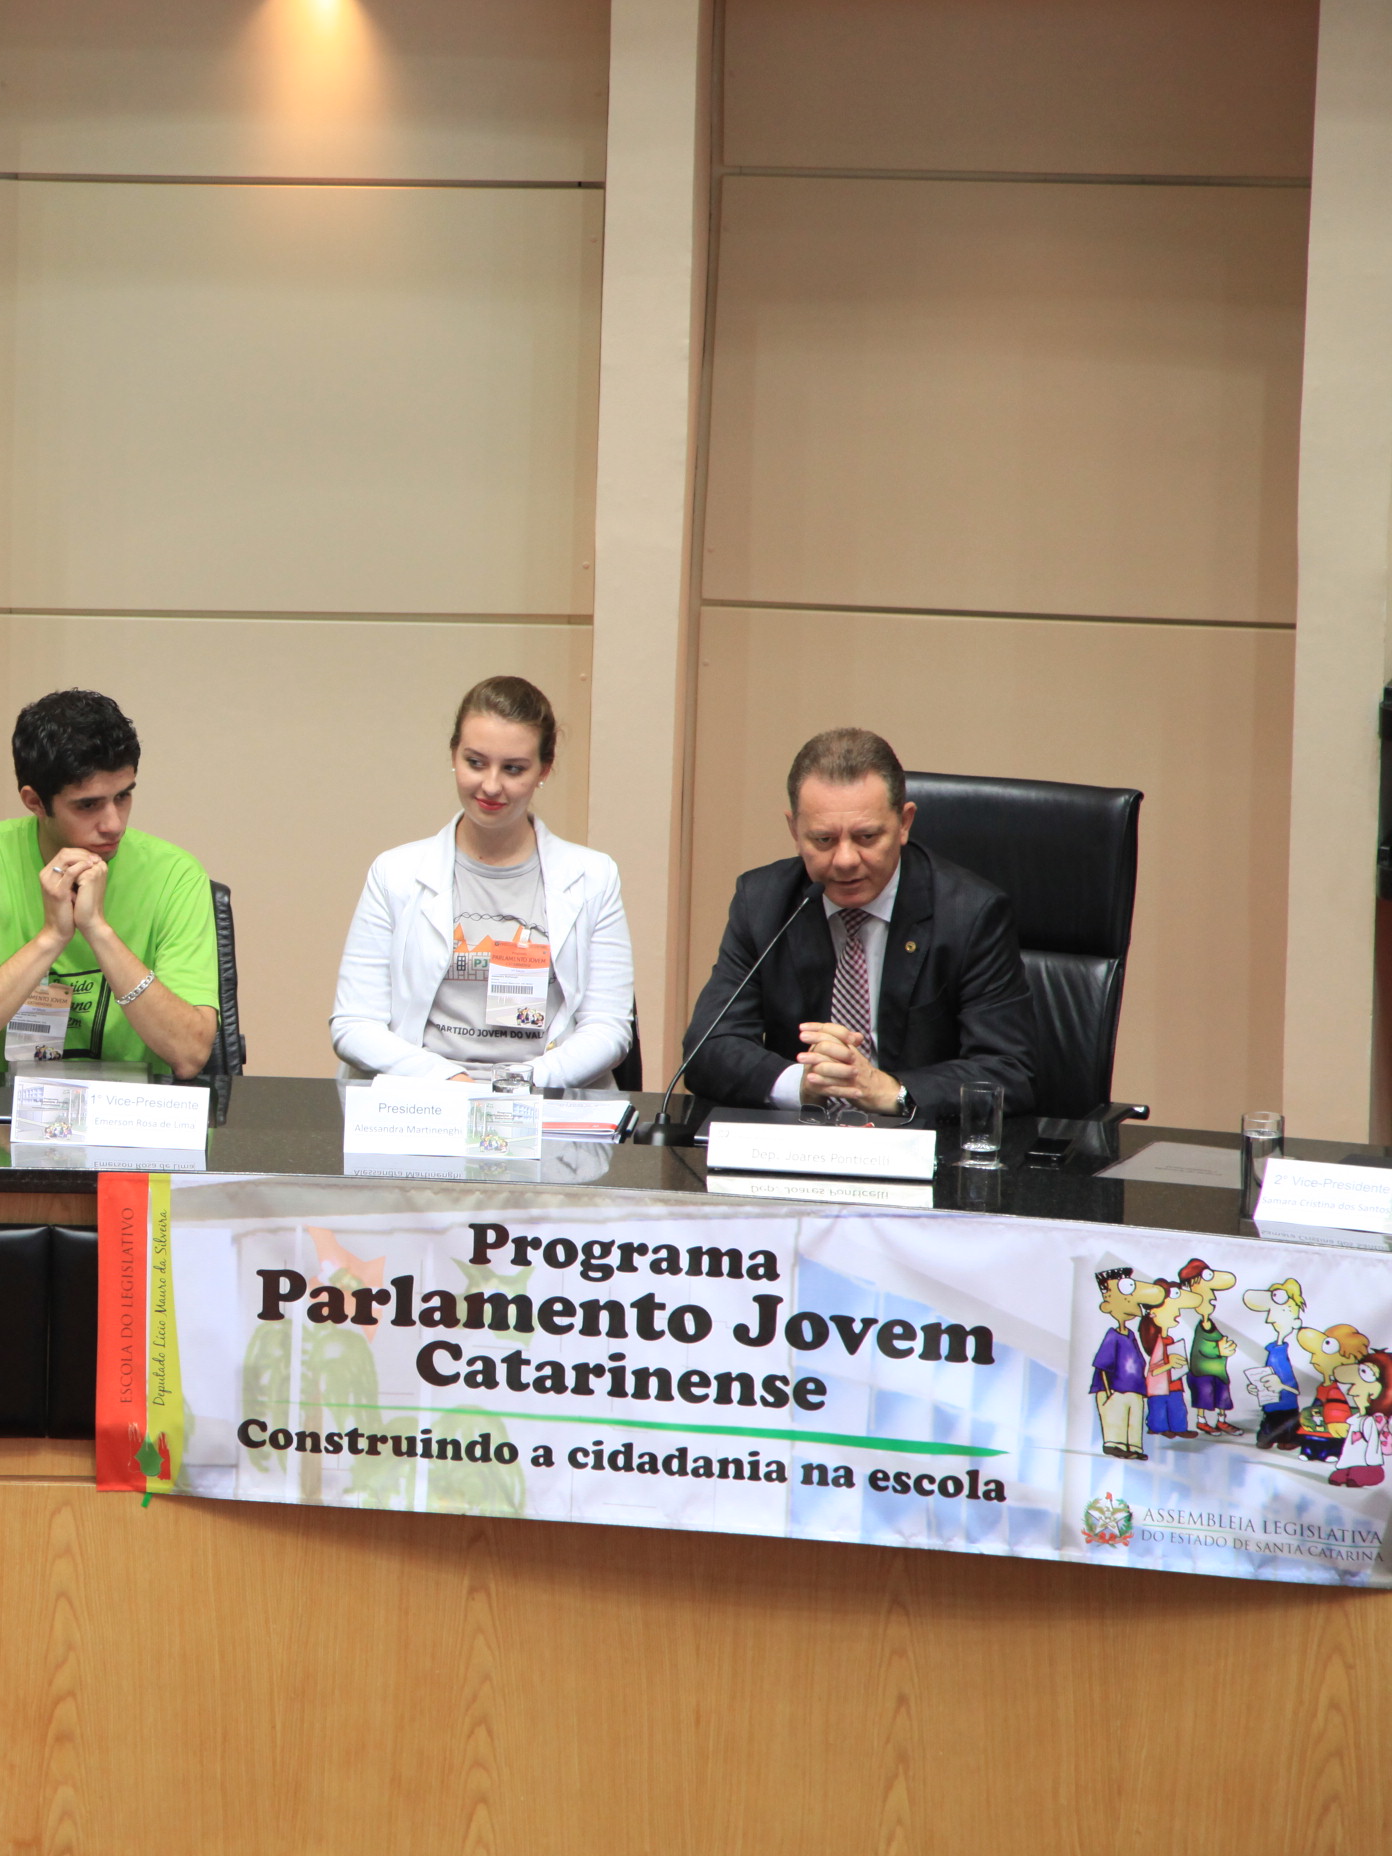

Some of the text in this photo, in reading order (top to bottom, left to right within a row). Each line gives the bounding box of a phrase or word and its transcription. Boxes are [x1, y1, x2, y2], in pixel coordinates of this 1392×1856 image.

[476, 1028, 508, 1039] JOVEM
[510, 1030, 524, 1040] DO
[106, 1095, 199, 1110] Vice-Presidente
[378, 1102, 442, 1116] Presidente
[94, 1117, 196, 1130] Emerson Rosa de Lima
[354, 1123, 463, 1136] Alessandra Martinenghi
[751, 1148, 891, 1167] Dep. Joares Ponticelli
[1292, 1175, 1391, 1194] Vice-Presidente
[1261, 1196, 1391, 1214] Samara Cristina dos Santos
[153, 1209, 168, 1255] Silveira
[153, 1258, 167, 1274] da
[468, 1223, 780, 1282] Programa
[120, 1207, 135, 1403] ESCOLA DO LEGISLATIVO
[154, 1278, 168, 1318] Mauro
[256, 1269, 995, 1365] Parlamento Jovem
[152, 1352, 172, 1406] Deputado
[416, 1340, 827, 1411] Catarinense
[237, 1418, 1007, 1502] Construindo a cidadania na escola
[1144, 1507, 1383, 1545] ASSEMBLEIA LEGISLATIVA
[1141, 1529, 1384, 1563] DO ESTADO DE SANTA CATARINA
